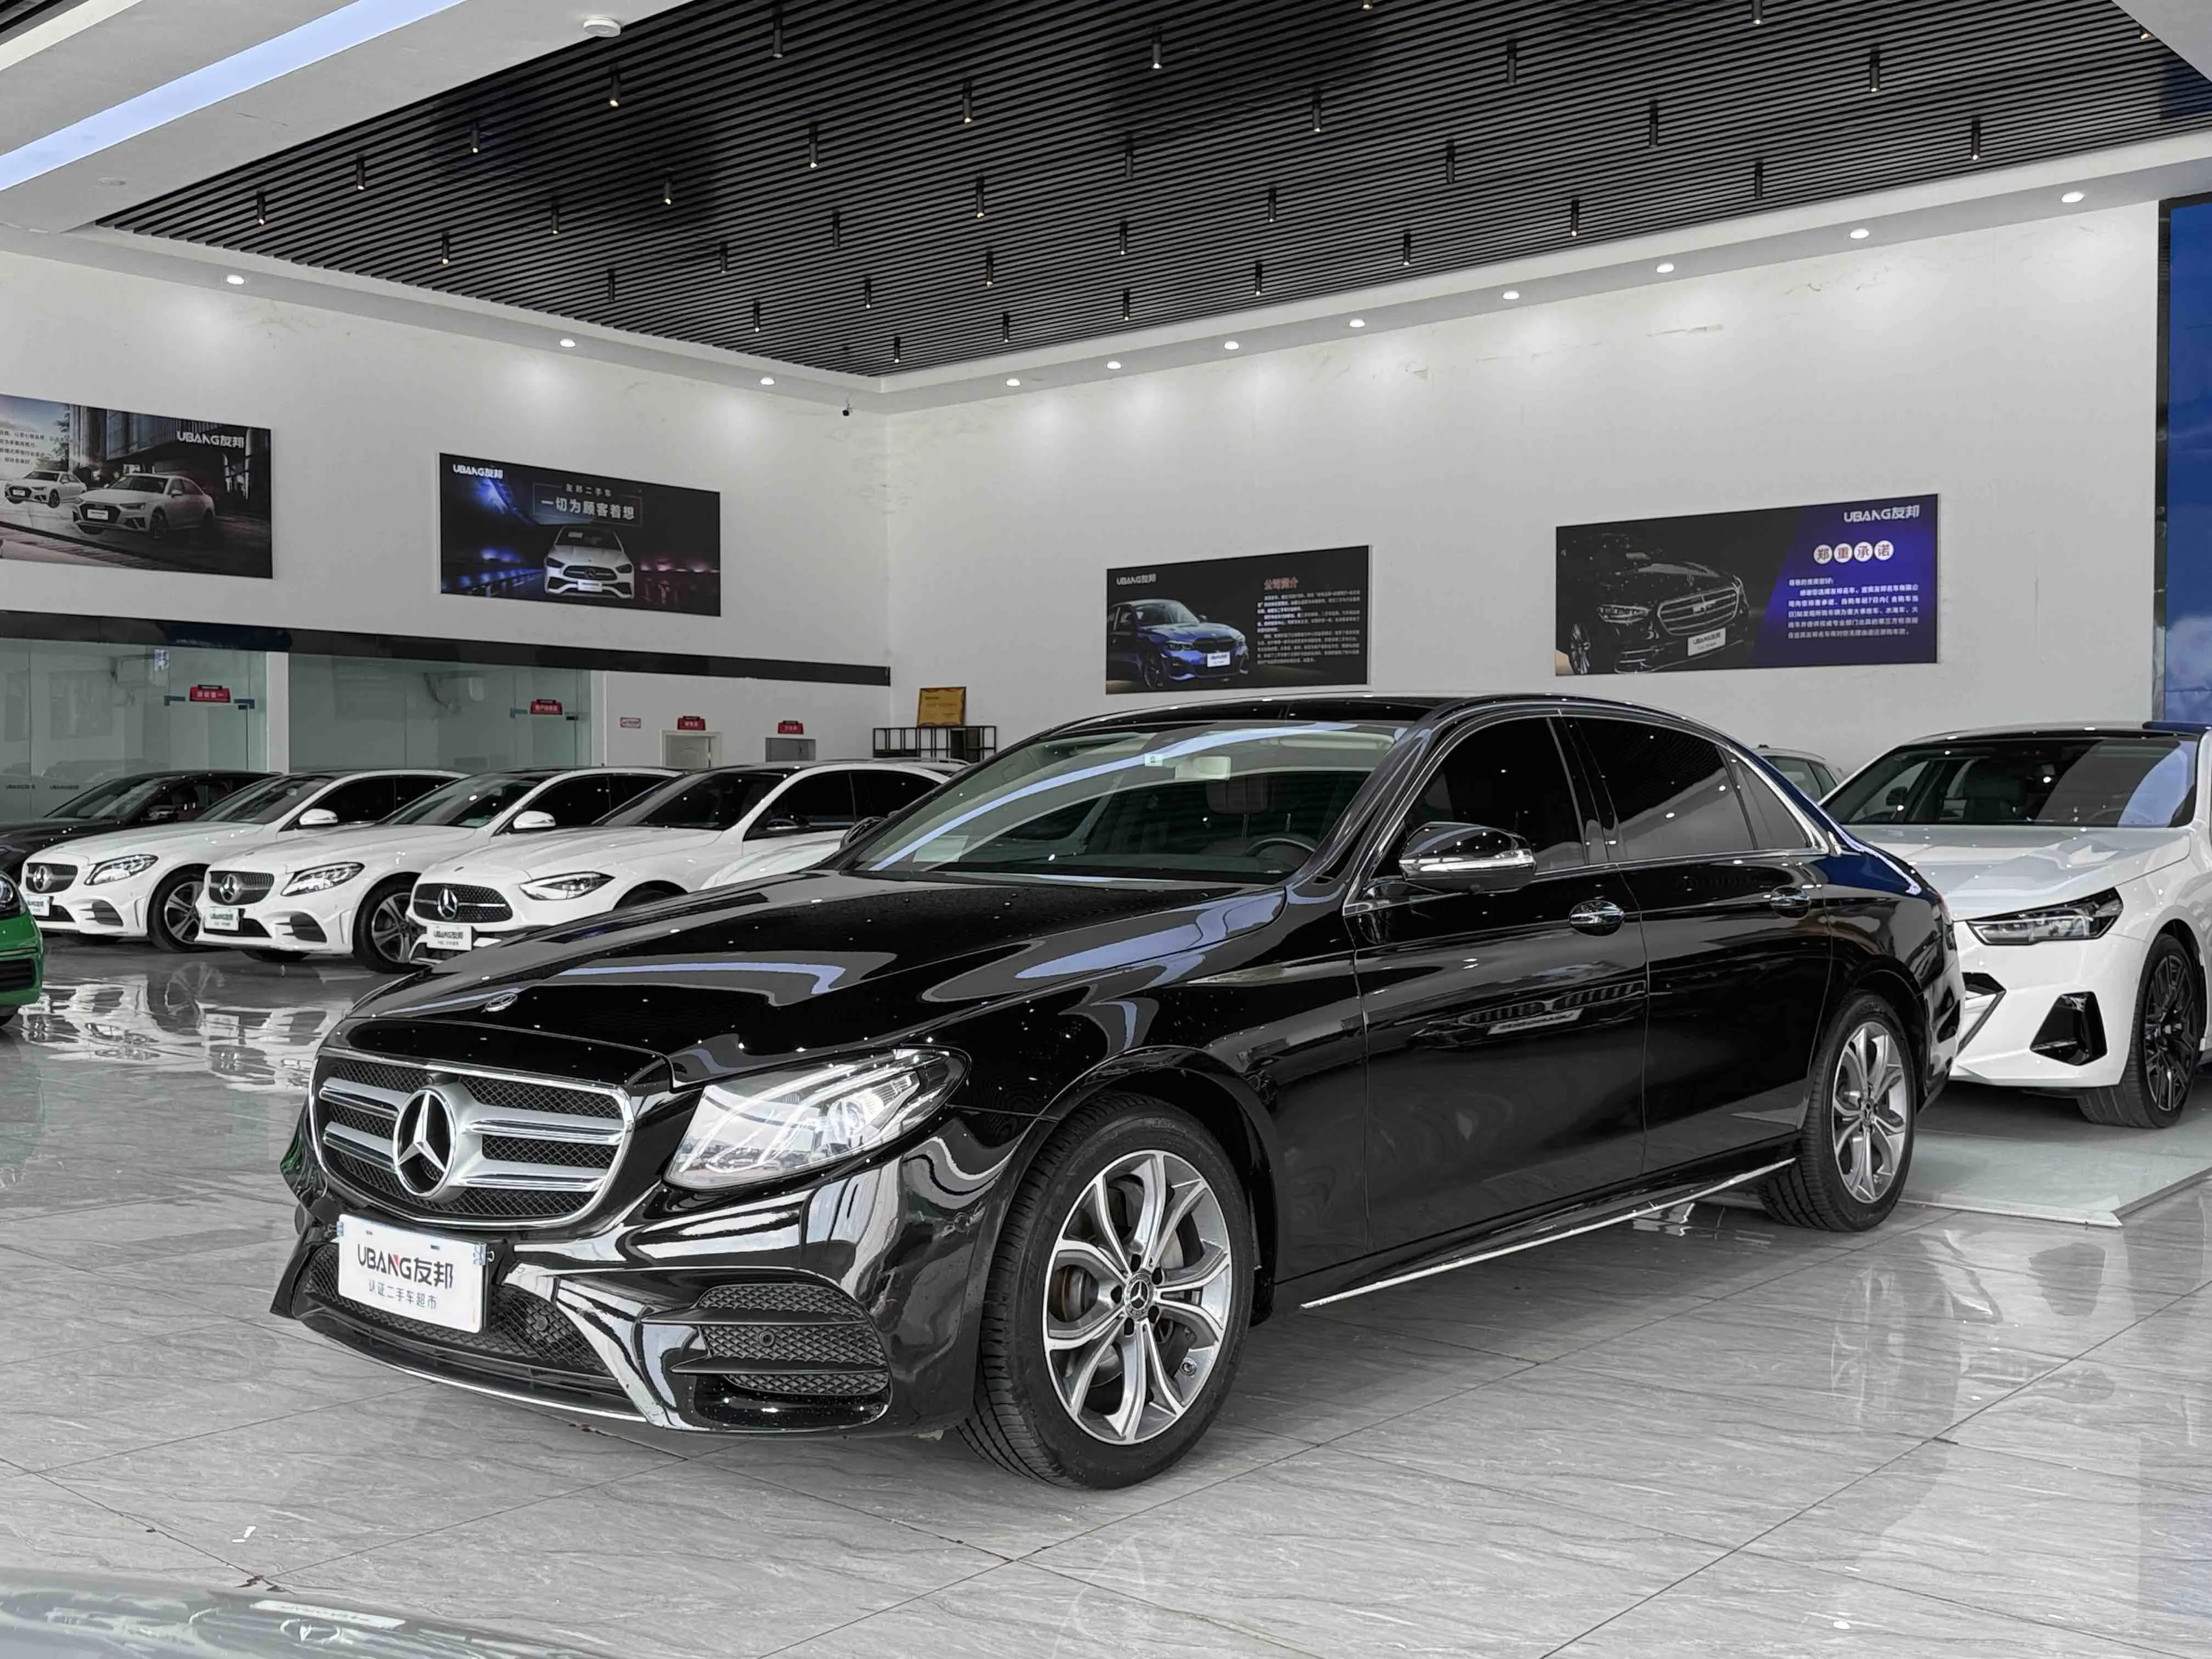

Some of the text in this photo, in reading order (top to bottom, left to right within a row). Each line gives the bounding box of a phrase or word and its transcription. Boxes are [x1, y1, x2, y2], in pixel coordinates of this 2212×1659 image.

[177, 431, 244, 448] UBANG友邦
[541, 496, 635, 520] 一切为顾客着想
[1843, 504, 1920, 522] UBANG友邦
[1817, 544, 1891, 560] 郑重承诺
[357, 1244, 454, 1289] UBANG友邦
[368, 1279, 437, 1310] 认证二手车超市
